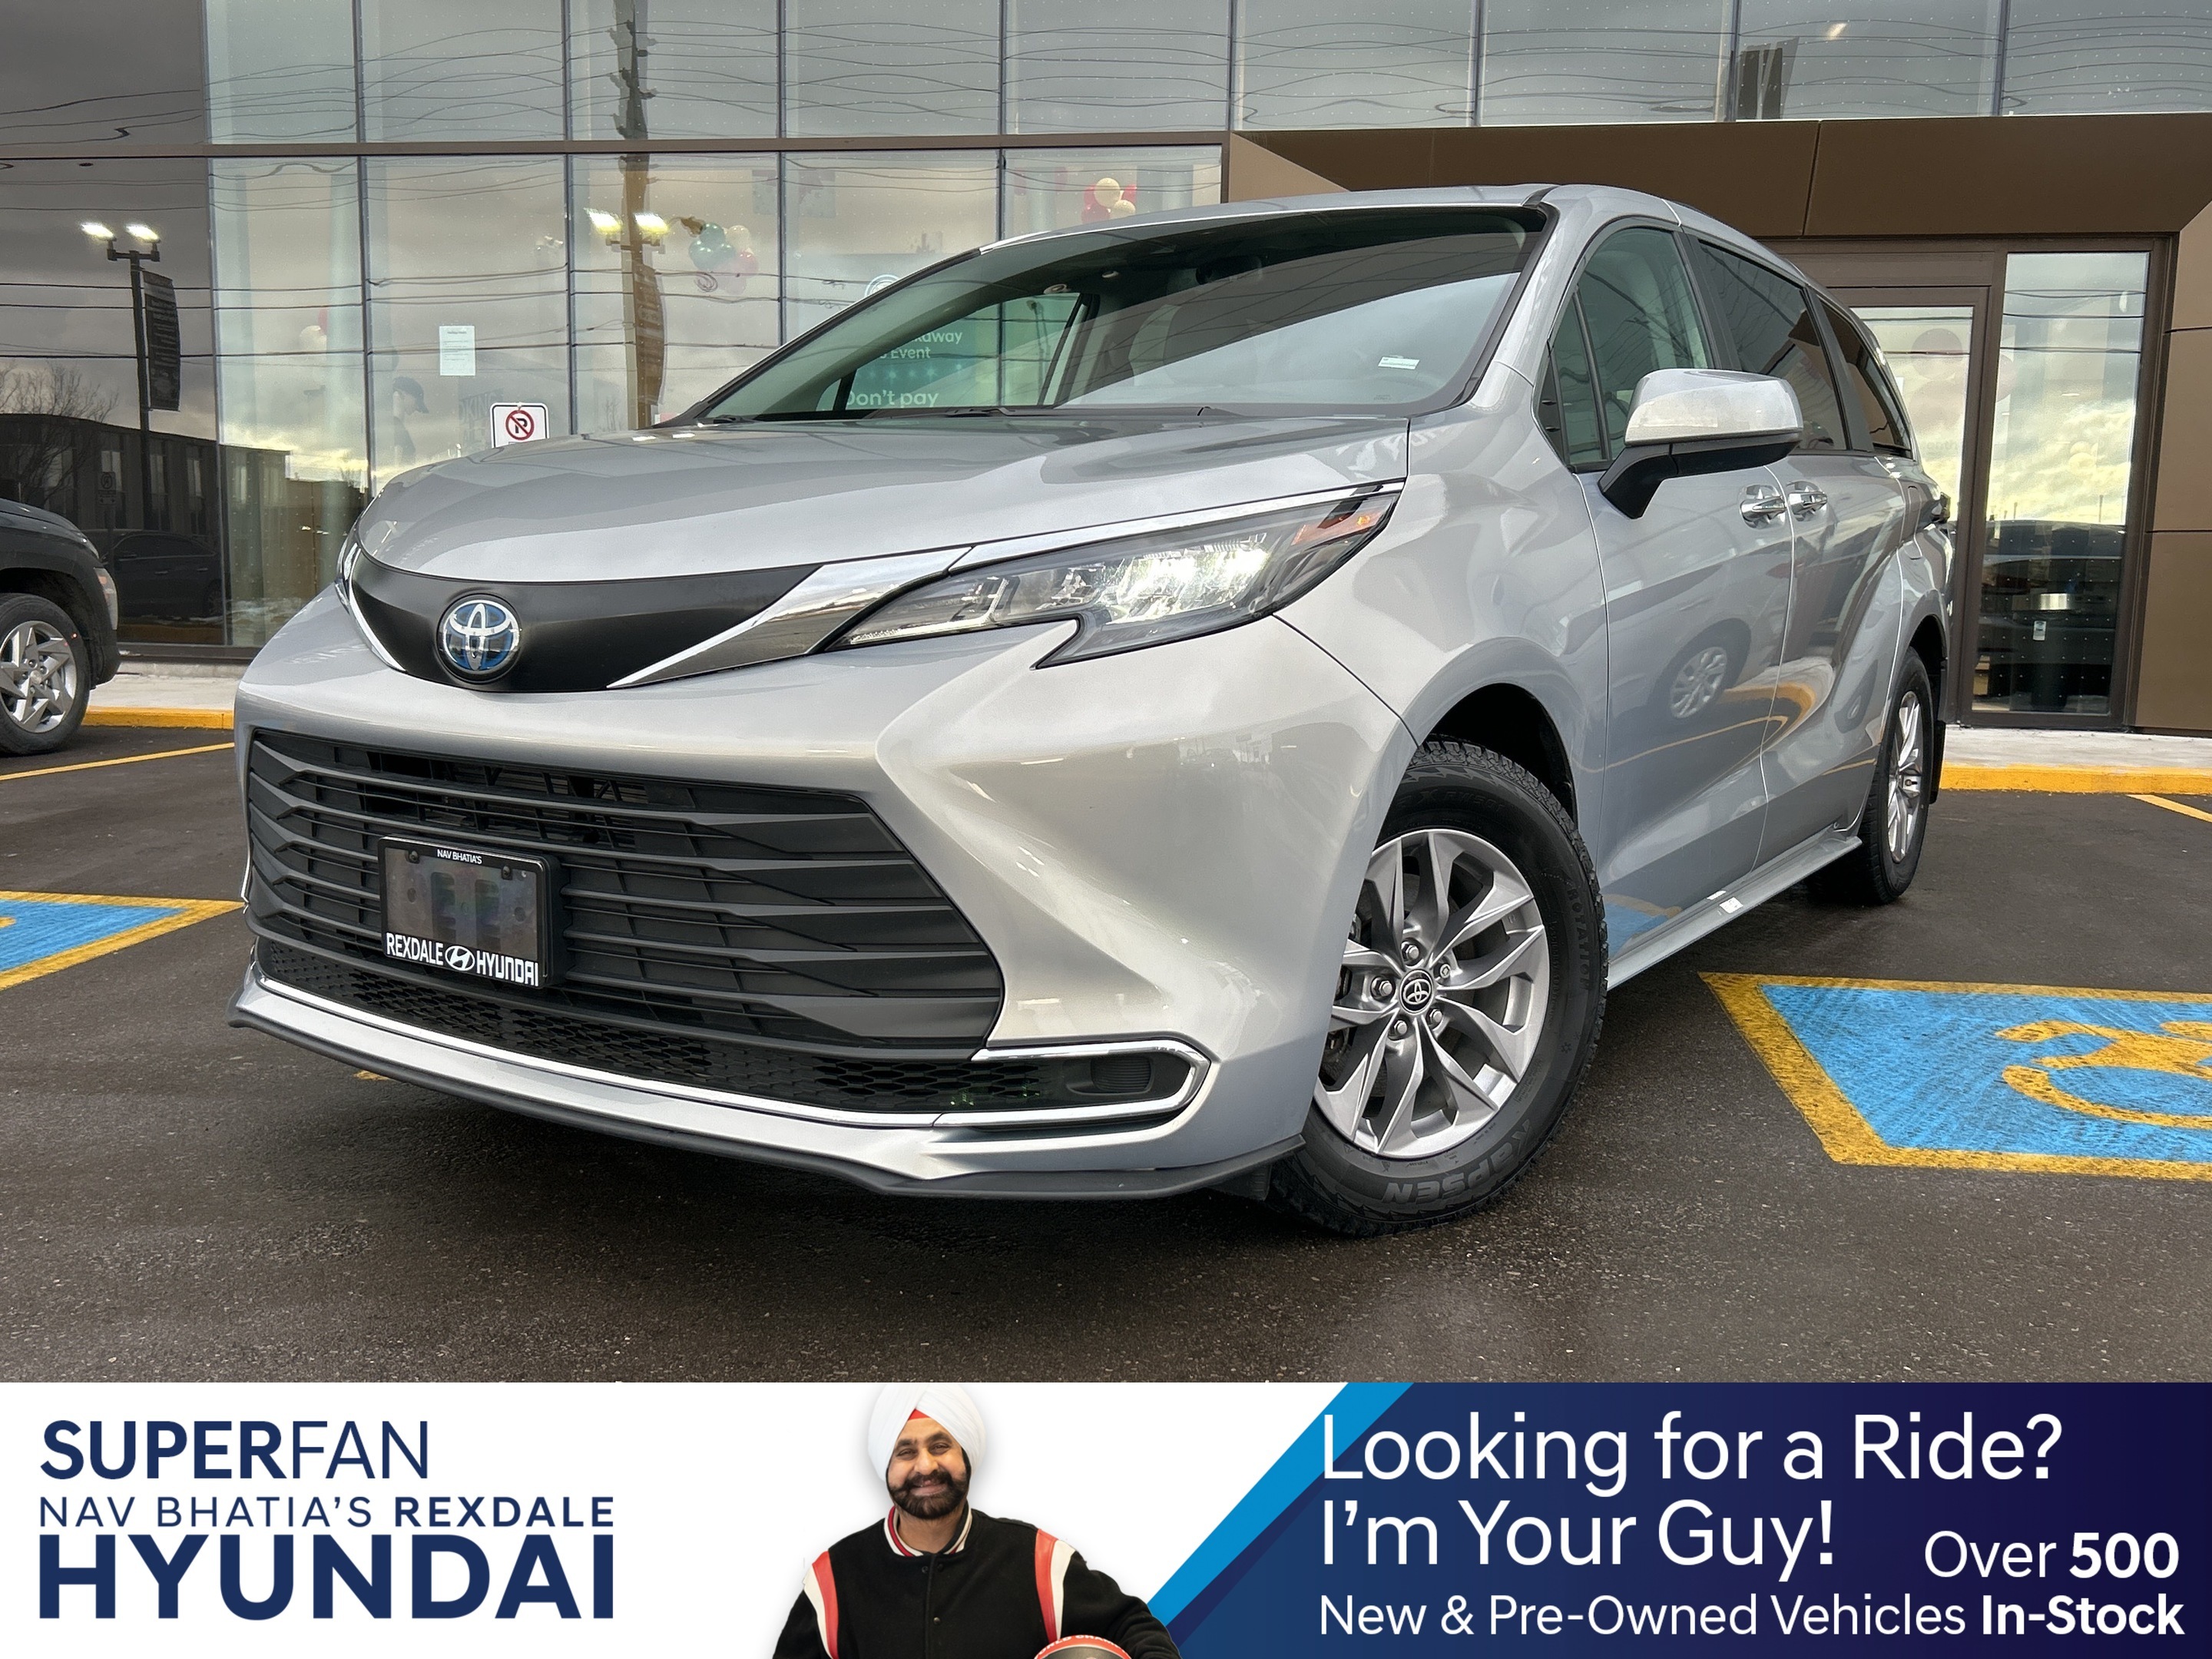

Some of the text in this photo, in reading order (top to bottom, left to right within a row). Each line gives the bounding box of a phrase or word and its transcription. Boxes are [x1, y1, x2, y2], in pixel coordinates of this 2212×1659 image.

[891, 347, 930, 359] Event
[901, 392, 939, 408] pay
[437, 849, 482, 864] NAV BHATIA'S
[386, 932, 539, 987] REXDALE HYUNDAI
